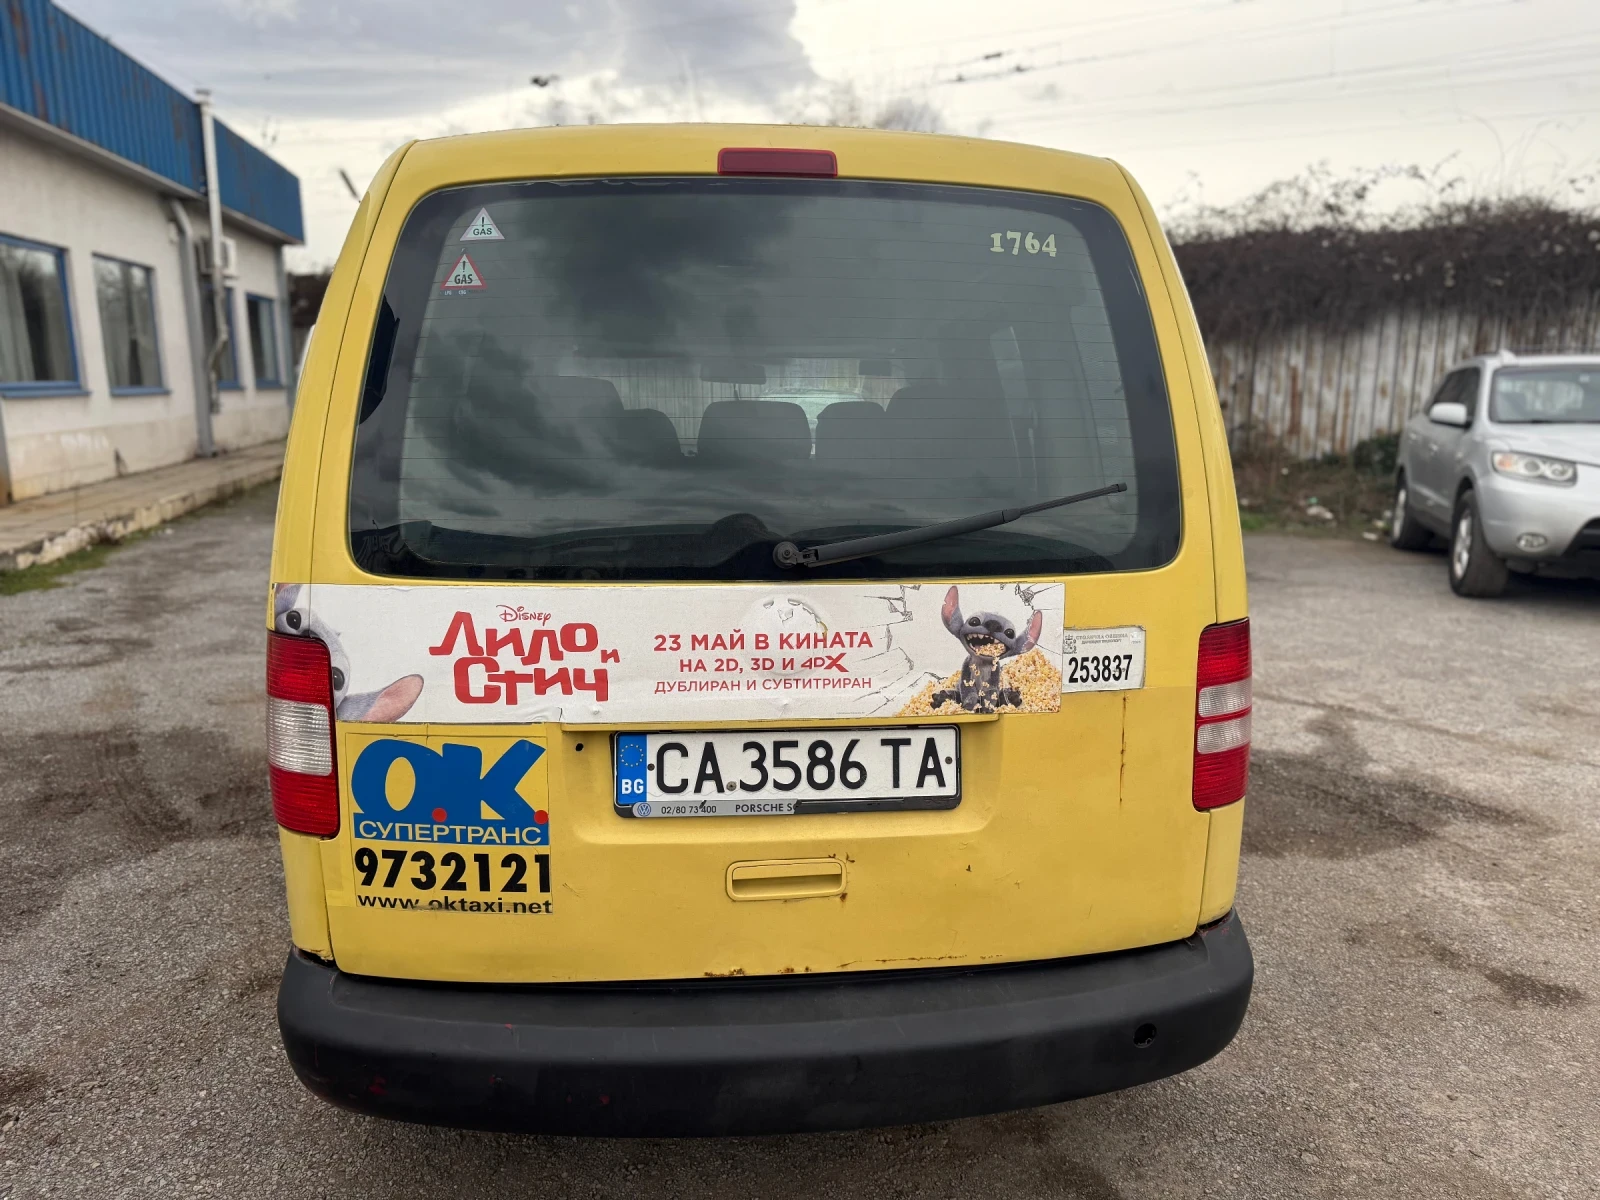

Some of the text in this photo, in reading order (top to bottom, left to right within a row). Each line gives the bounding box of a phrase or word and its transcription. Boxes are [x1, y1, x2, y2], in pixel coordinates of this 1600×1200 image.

[990, 230, 1057, 257] 1764
[454, 274, 473, 285] GAS
[653, 628, 874, 652] 23 МАЙ В КИНАТА
[679, 652, 850, 674] НА 2D, 3D И 4DX
[1068, 654, 1133, 683] 253837
[654, 677, 872, 694] ДУБЛИРАН И СУБТИТРИРАН
[621, 779, 644, 795] BG
[739, 738, 867, 792] 3586
[880, 737, 946, 789] TA
[661, 805, 686, 815] 02/80
[689, 805, 699, 814] 73
[700, 805, 717, 814] 400
[735, 803, 784, 813] PORSCHE
[359, 820, 542, 845] СУПЕРТРАНС
[354, 847, 551, 893] 9732121
[357, 895, 553, 914] wwwoktaxi.net
